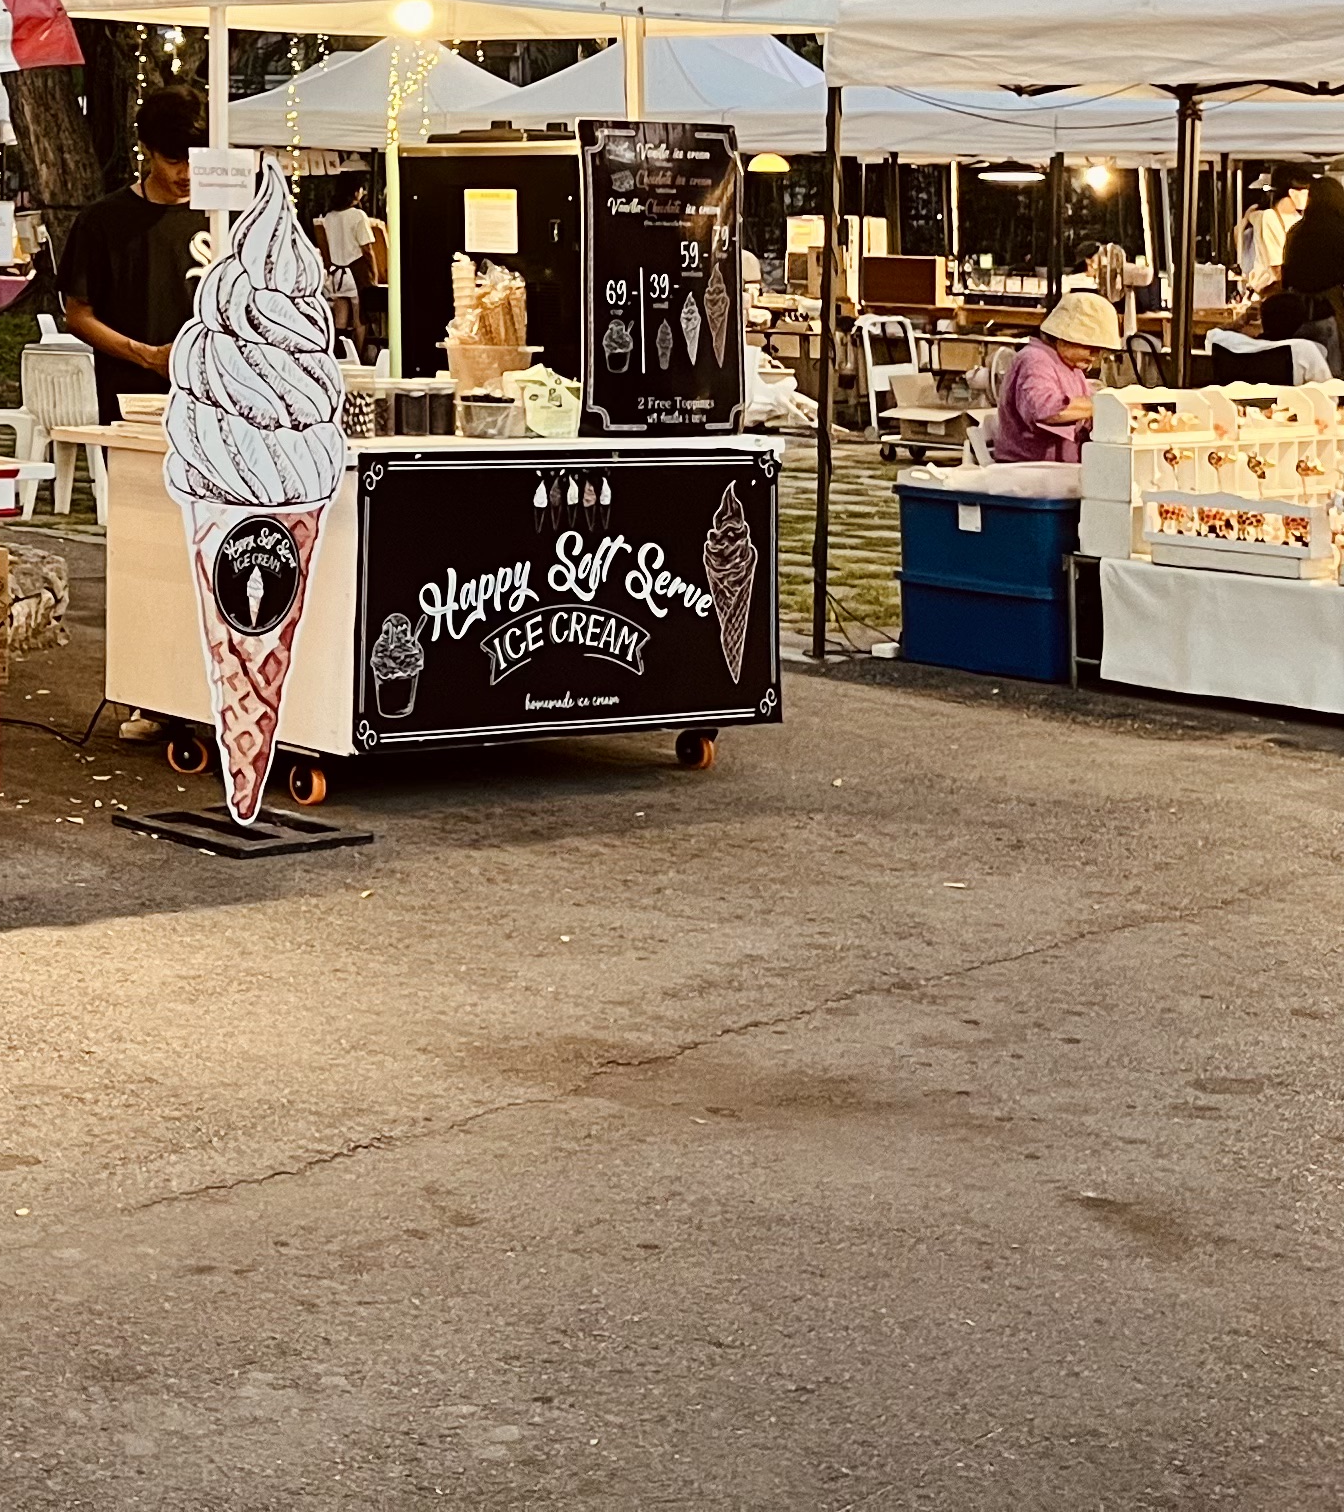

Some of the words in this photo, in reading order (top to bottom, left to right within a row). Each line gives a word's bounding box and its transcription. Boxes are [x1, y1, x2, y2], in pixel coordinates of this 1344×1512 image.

[193, 166, 228, 176] COUPON
[231, 167, 252, 177] ONLY
[637, 397, 645, 409] 2
[647, 397, 672, 409] Free
[233, 553, 251, 573] ICE
[252, 553, 280, 572] CREAM
[419, 561, 539, 642] Happy
[547, 530, 632, 602] Soft
[625, 542, 713, 618] Serve
[493, 614, 544, 670] ICE
[550, 611, 639, 662] CREAM
[525, 690, 575, 710] homemade
[577, 696, 590, 707] ice
[592, 696, 620, 706] cream
